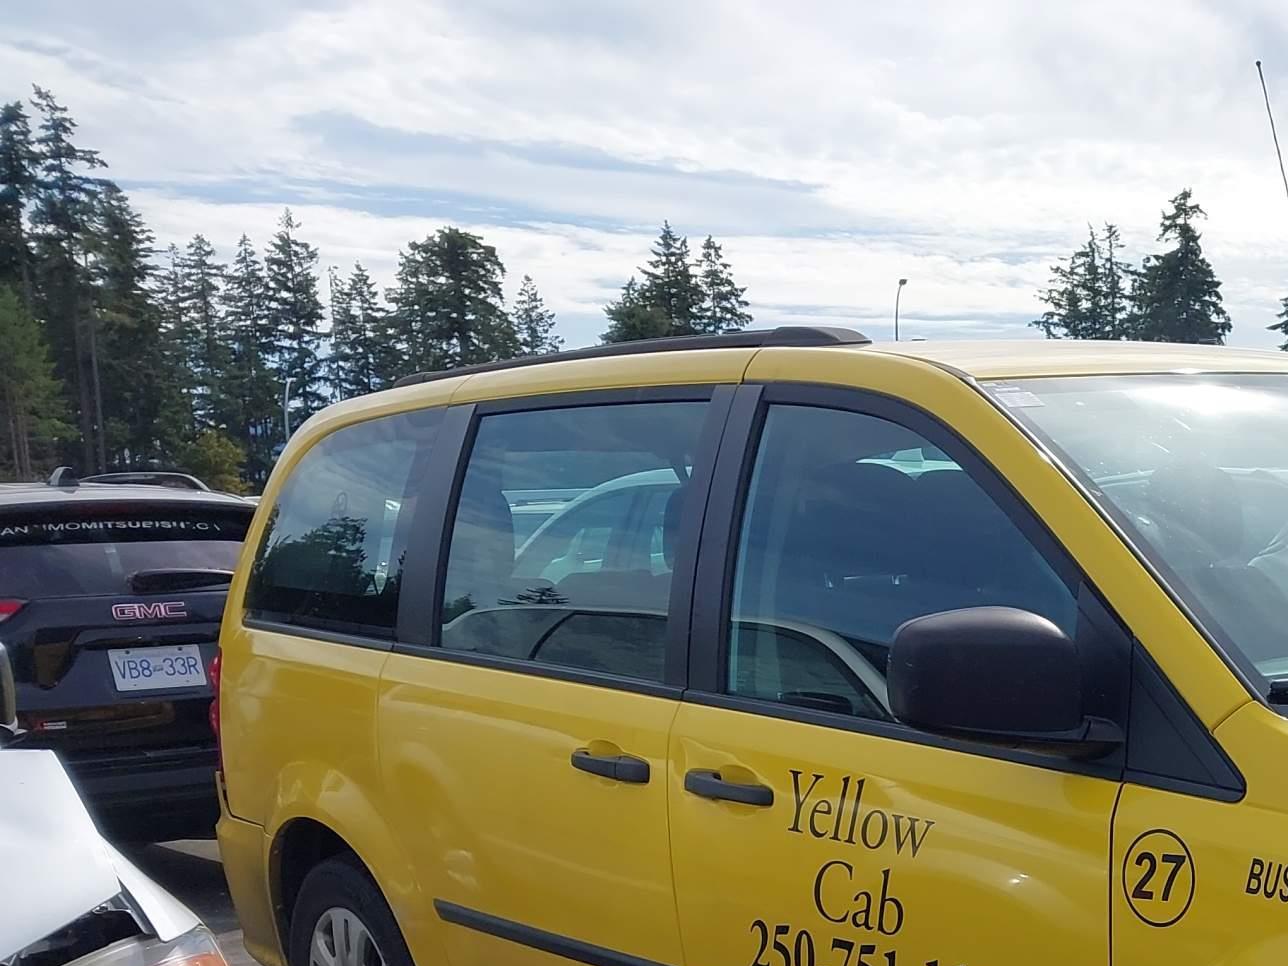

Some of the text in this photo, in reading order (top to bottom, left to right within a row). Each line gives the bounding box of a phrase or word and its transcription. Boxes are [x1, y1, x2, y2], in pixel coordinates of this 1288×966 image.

[112, 601, 187, 620] GMC
[787, 769, 936, 859] Yellow
[813, 860, 905, 937] Cab
[1131, 851, 1187, 902] 27
